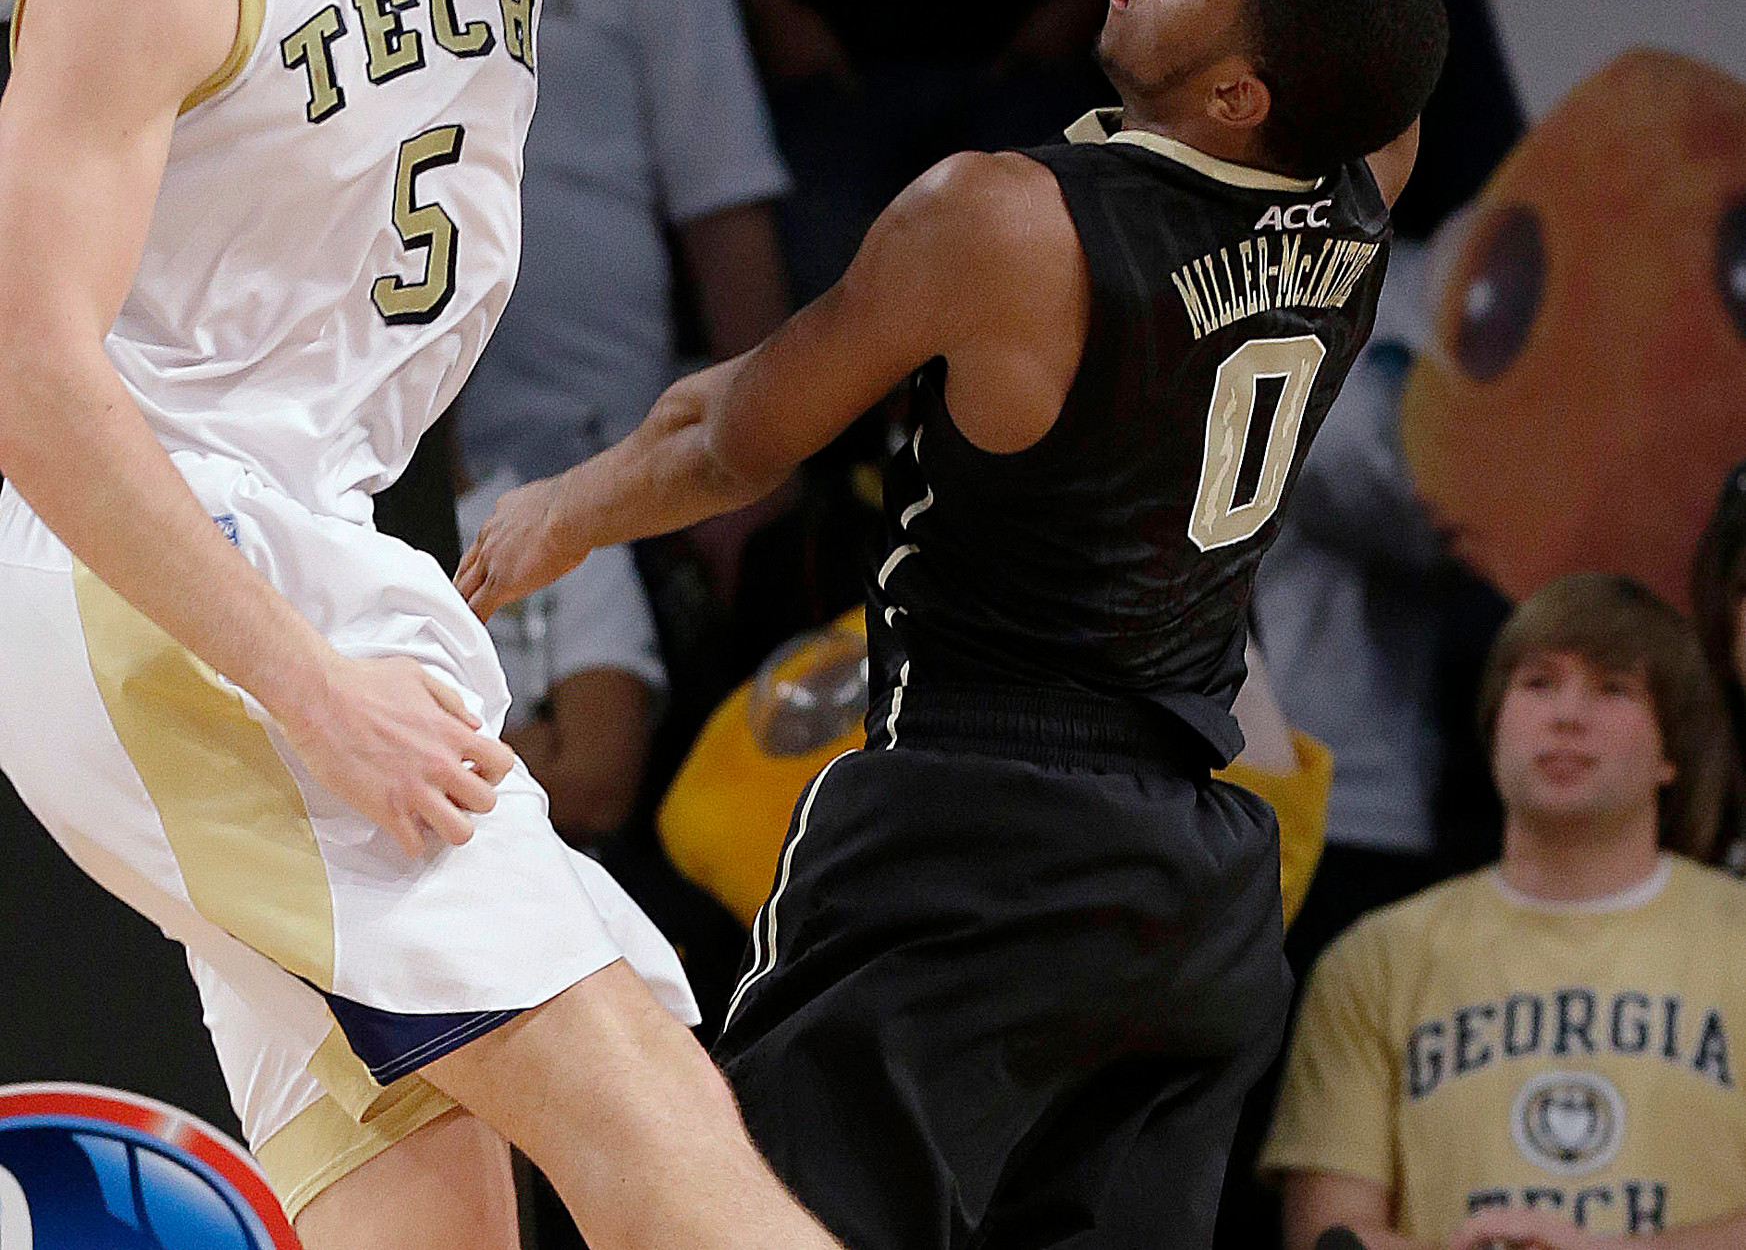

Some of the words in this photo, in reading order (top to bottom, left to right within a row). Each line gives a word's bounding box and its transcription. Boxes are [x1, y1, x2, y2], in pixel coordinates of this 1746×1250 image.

[370, 124, 465, 326] 5
[1254, 200, 1331, 230] ACC
[1188, 334, 1326, 552] 0
[1406, 986, 1733, 1100] GEORGIA
